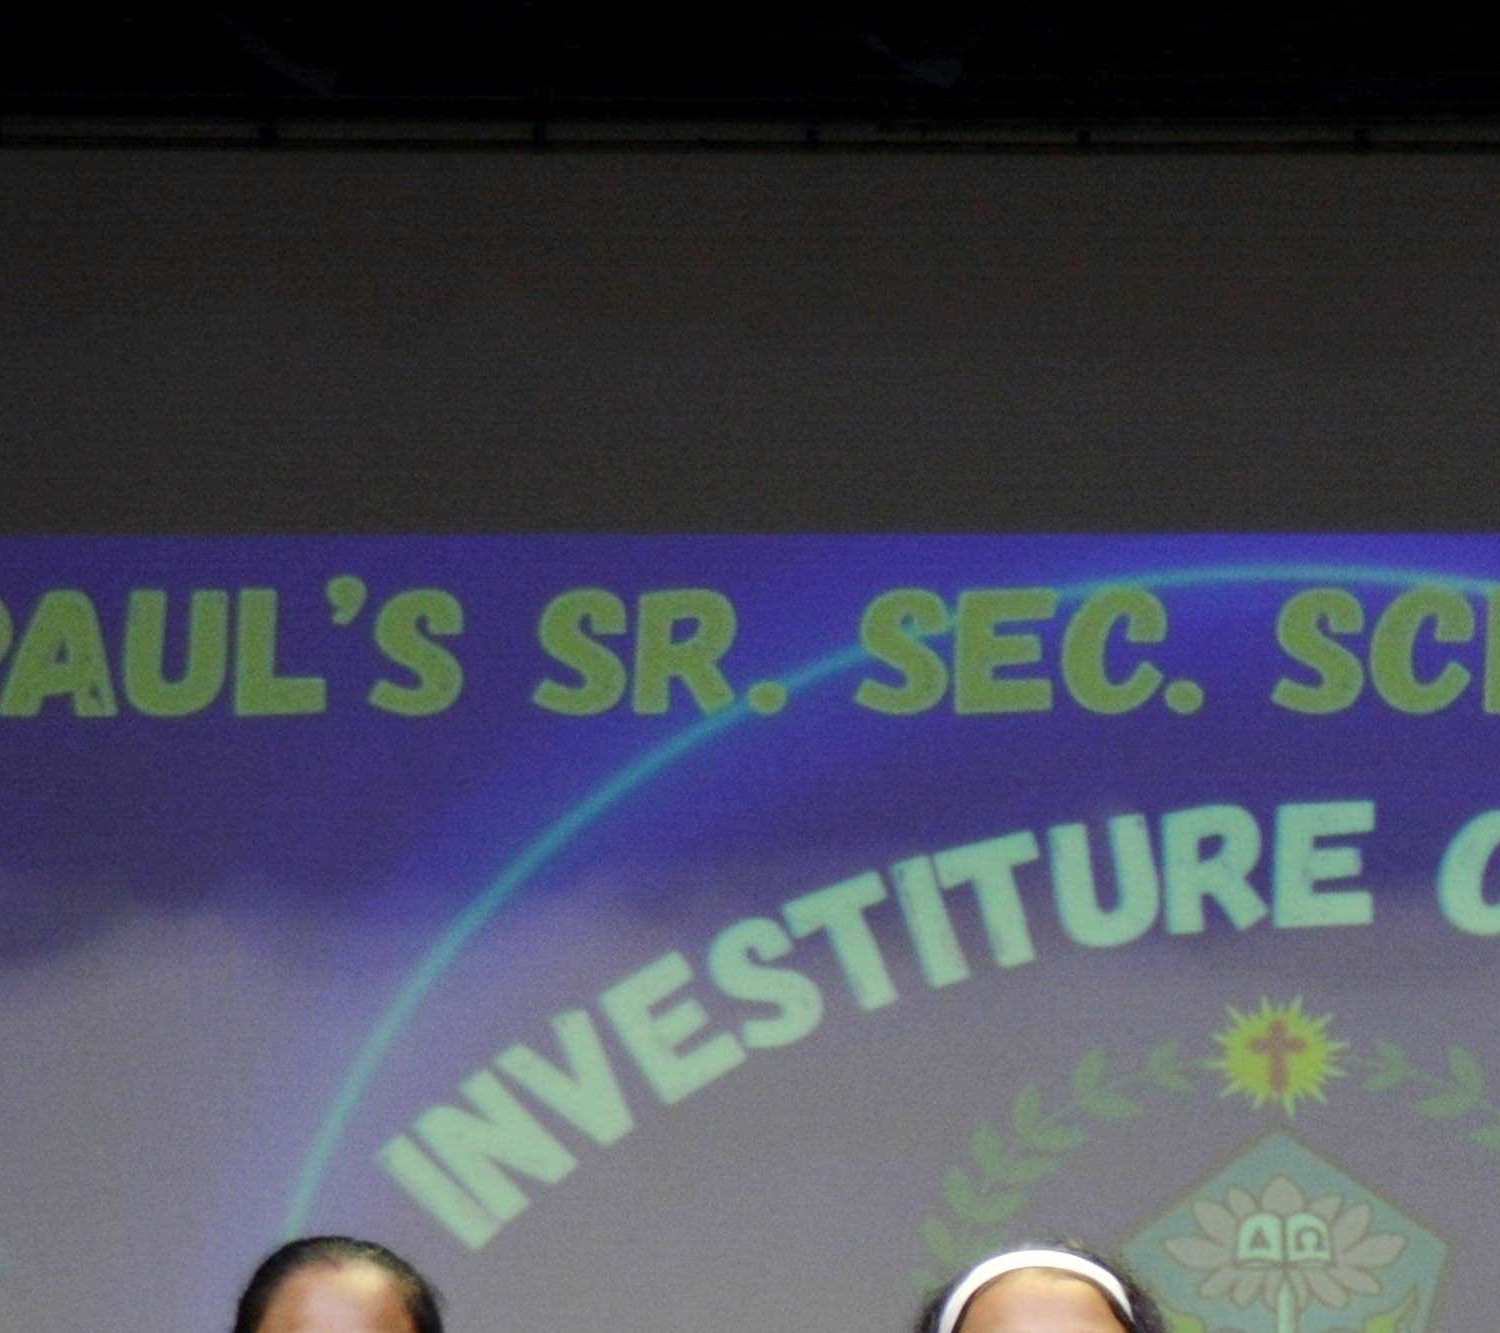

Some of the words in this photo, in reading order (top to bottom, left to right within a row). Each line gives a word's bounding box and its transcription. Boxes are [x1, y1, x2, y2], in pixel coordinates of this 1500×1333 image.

[534, 588, 788, 715] SR.
[856, 584, 1204, 714] SEC.
[376, 801, 1375, 1250] INVESTITURE
